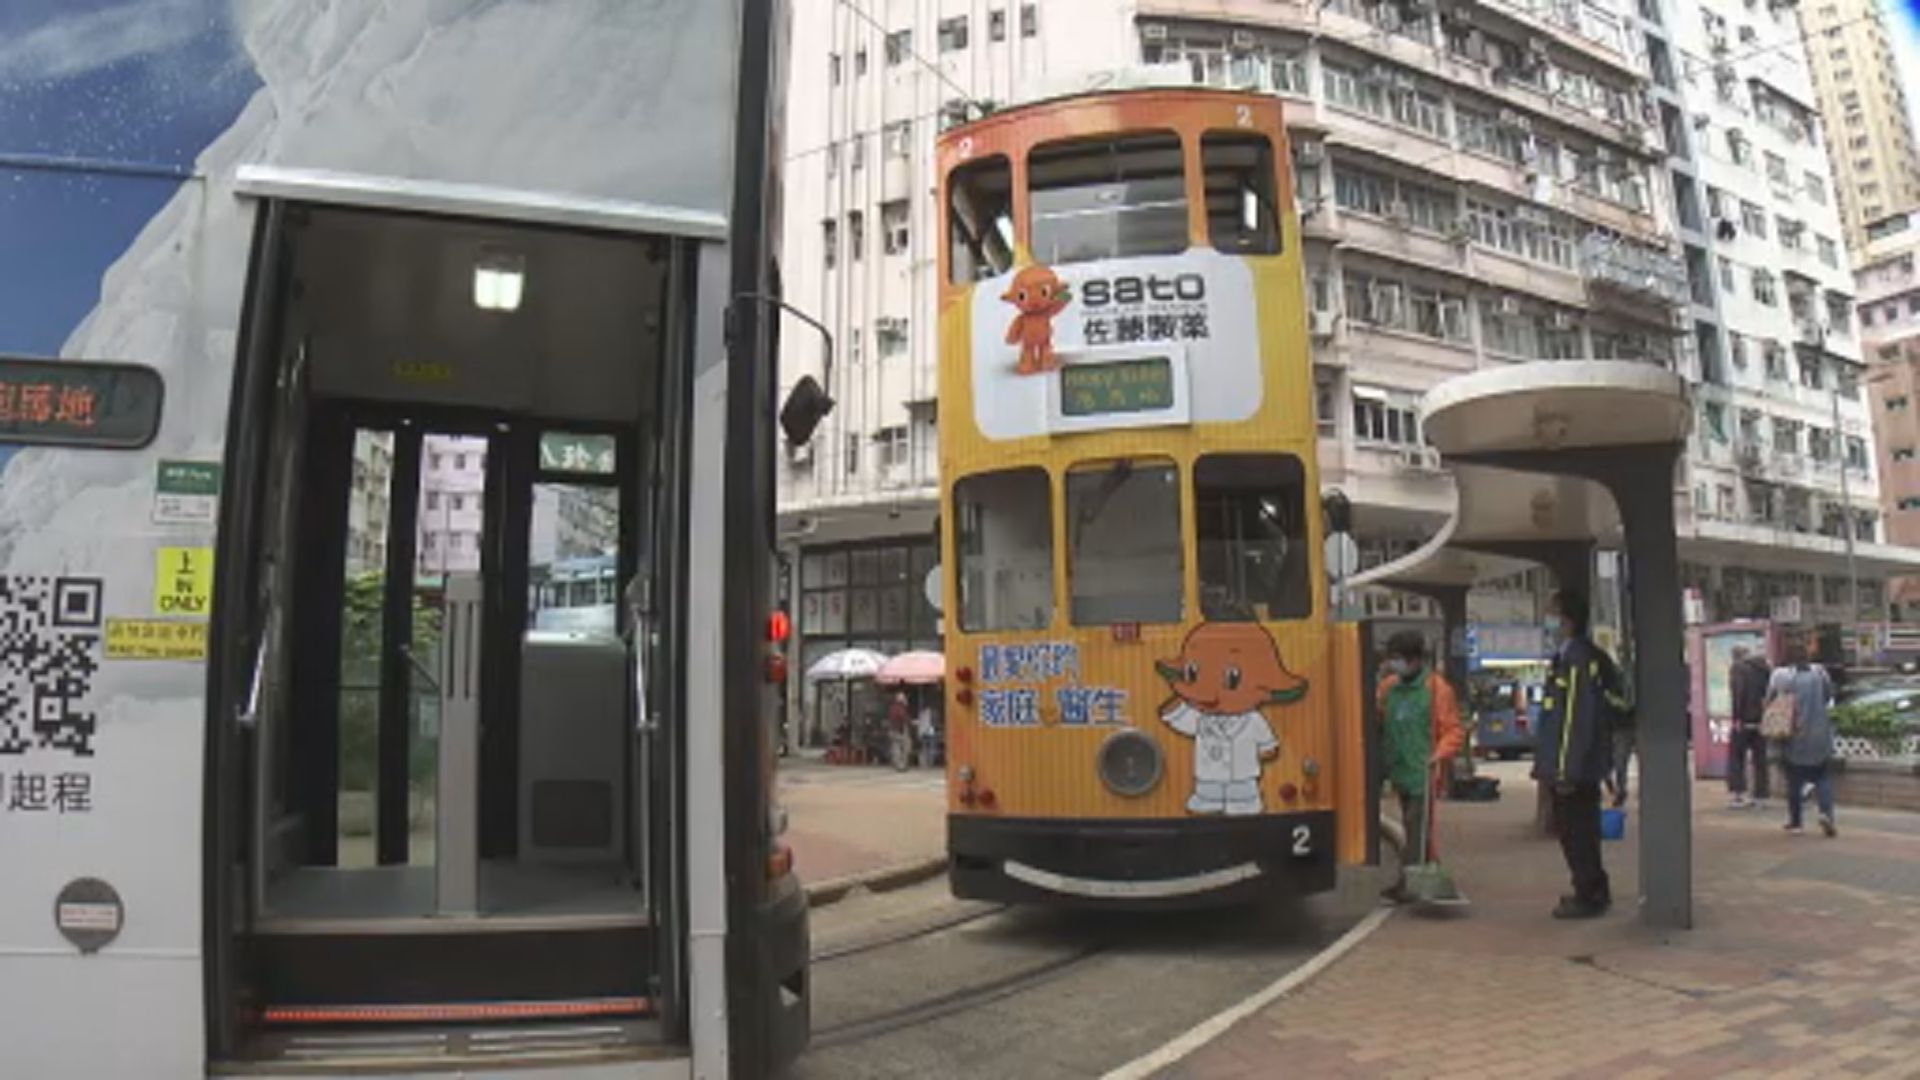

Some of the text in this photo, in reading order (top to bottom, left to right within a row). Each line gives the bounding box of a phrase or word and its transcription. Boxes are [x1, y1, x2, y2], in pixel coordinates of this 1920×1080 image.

[1236, 105, 1253, 127] 2
[1083, 272, 1205, 308] sato
[177, 551, 195, 575] 上
[176, 578, 193, 593] IN
[160, 595, 207, 611] ONLY
[0, 770, 93, 814] 起程
[1291, 826, 1311, 854] 2
